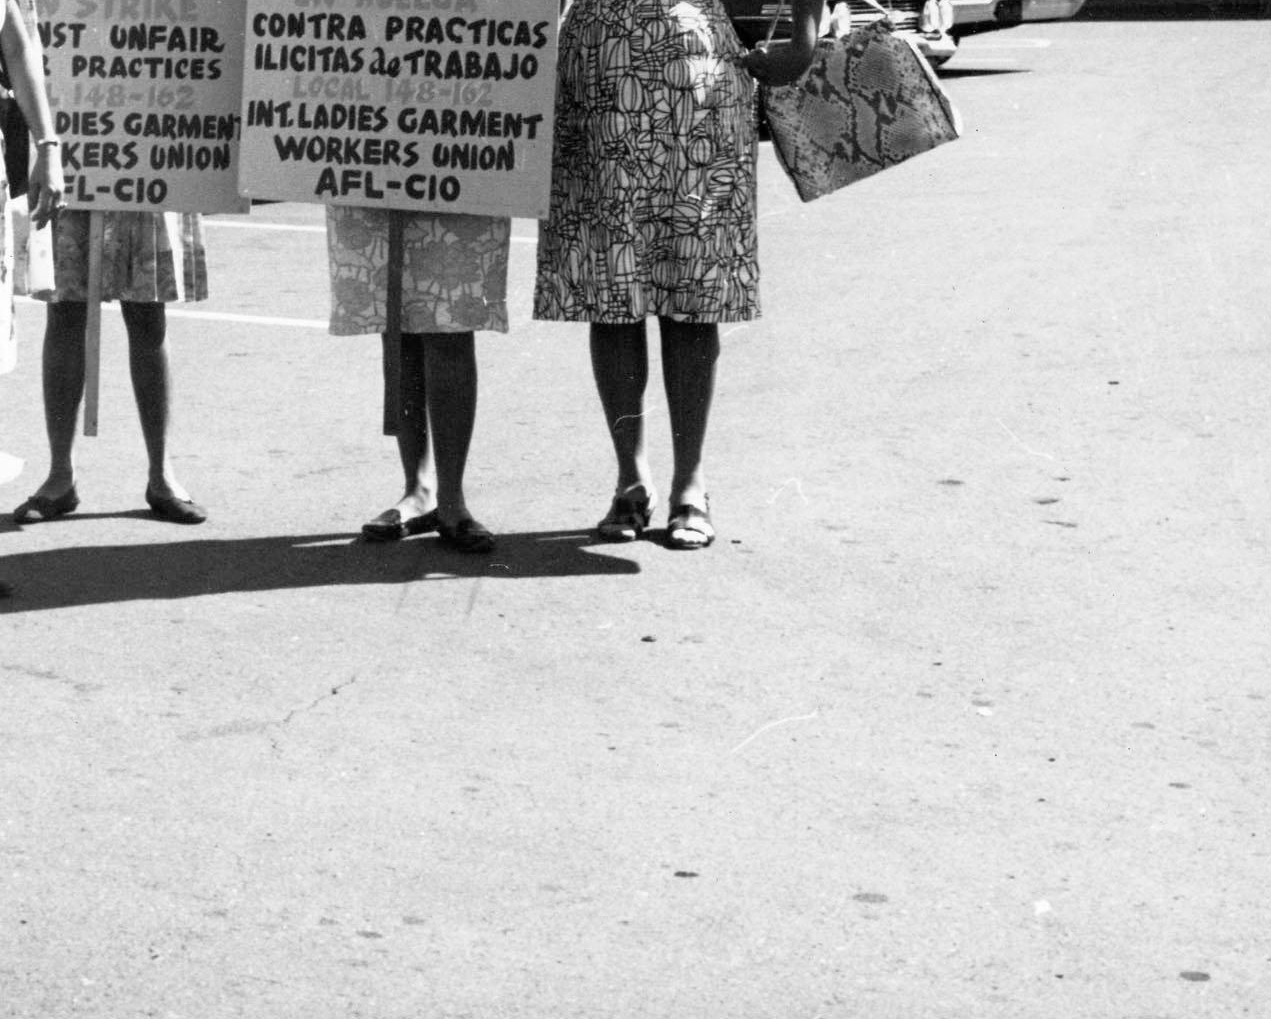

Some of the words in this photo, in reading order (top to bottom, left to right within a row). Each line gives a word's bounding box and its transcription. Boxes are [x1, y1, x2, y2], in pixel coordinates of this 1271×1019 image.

[109, 23, 225, 53] UNFAIR
[252, 11, 367, 42] CONTRA
[385, 16, 549, 49] PRACTICAS
[72, 55, 223, 80] PRACTICES
[254, 43, 364, 74] ILICITAS
[369, 47, 401, 78] de
[403, 49, 538, 81] TRABAJO
[74, 83, 195, 110] 148-162
[292, 75, 370, 101] LOCAL
[385, 82, 492, 107] 148-162
[55, 111, 115, 137] DIES
[247, 100, 294, 128] INT.
[297, 102, 388, 133] LADIES
[397, 108, 543, 140] GARMENT
[61, 141, 138, 172] KERS
[150, 143, 230, 172] UNION
[274, 134, 420, 168] WORKERS
[432, 139, 516, 171] UNION
[64, 176, 168, 204] L-CIO
[315, 167, 460, 202] AFL-CIO
